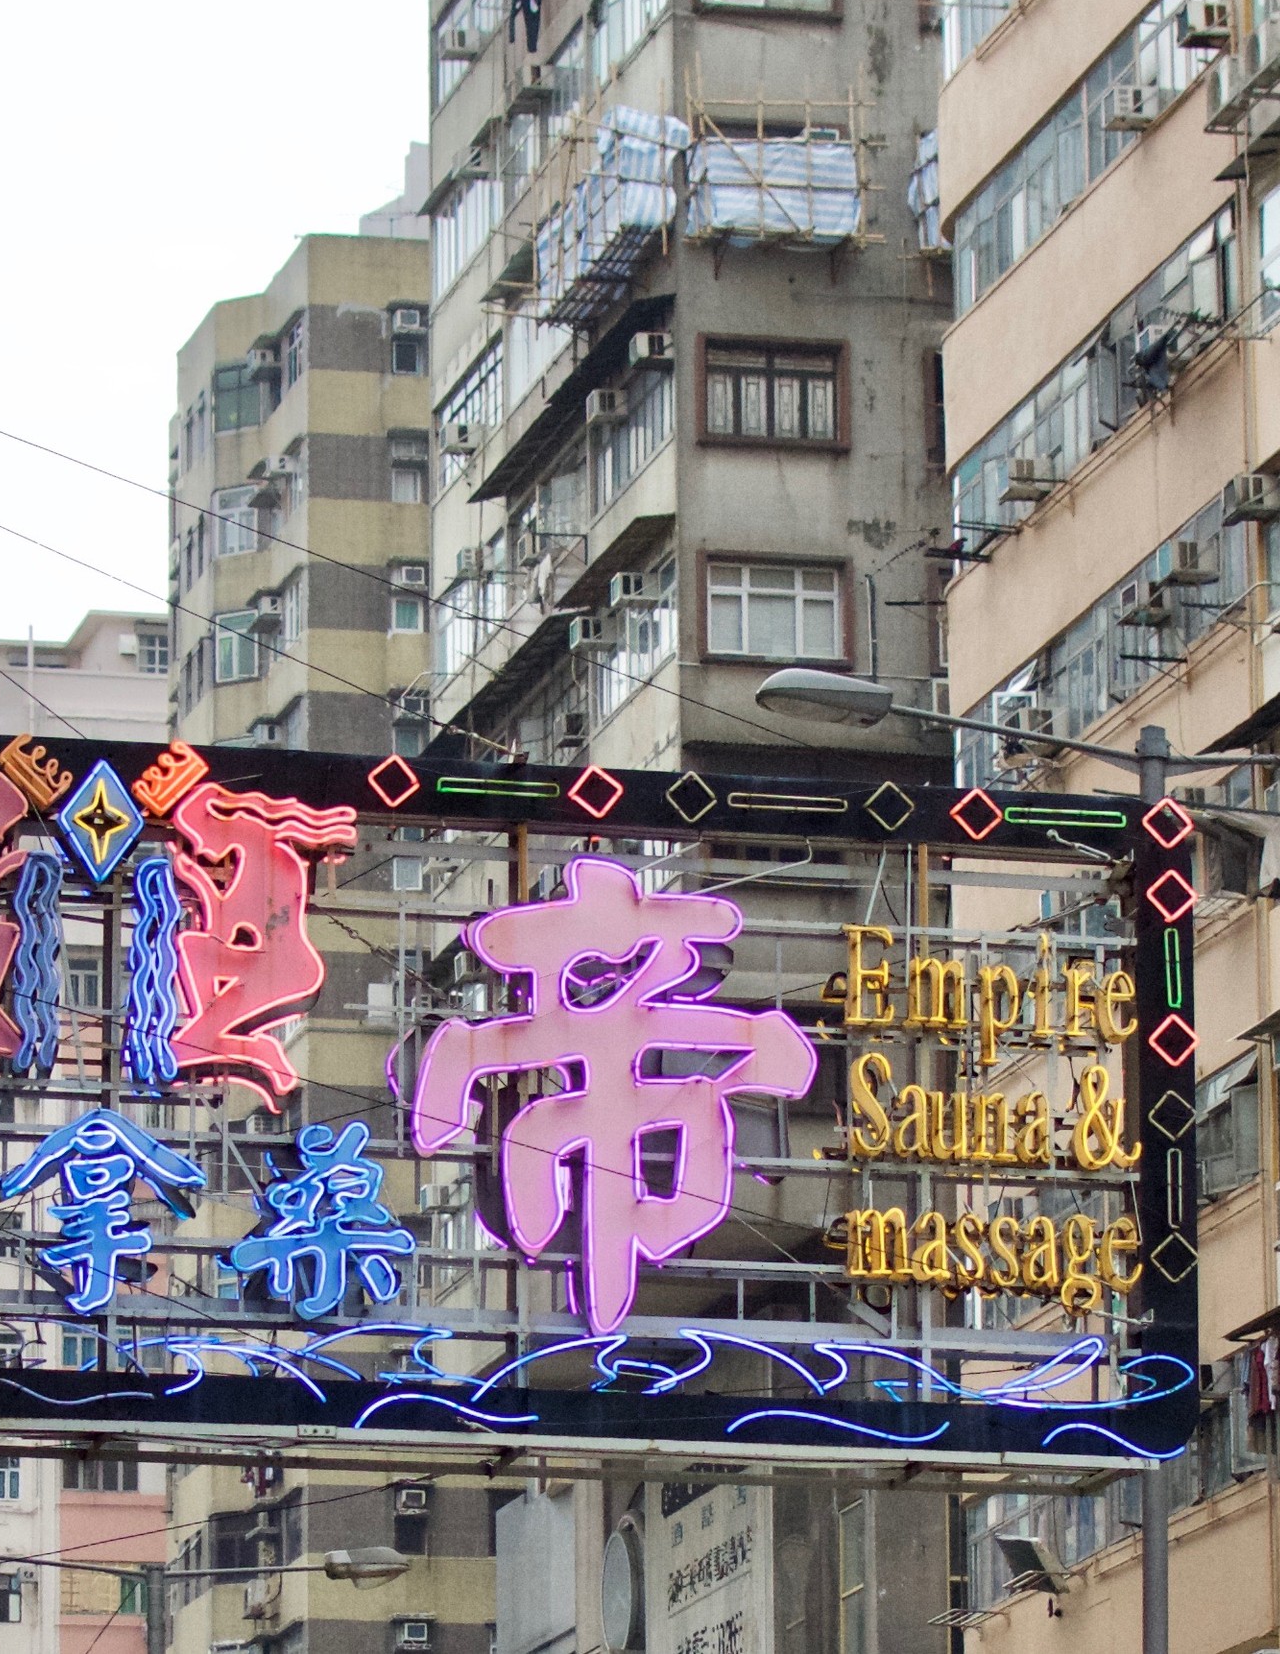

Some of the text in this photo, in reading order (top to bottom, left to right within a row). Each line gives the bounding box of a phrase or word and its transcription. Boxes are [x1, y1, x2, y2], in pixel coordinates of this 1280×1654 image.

[843, 924, 1140, 1065] Empire
[848, 1052, 1142, 1171] Sauna &
[843, 1206, 1144, 1318] massage
